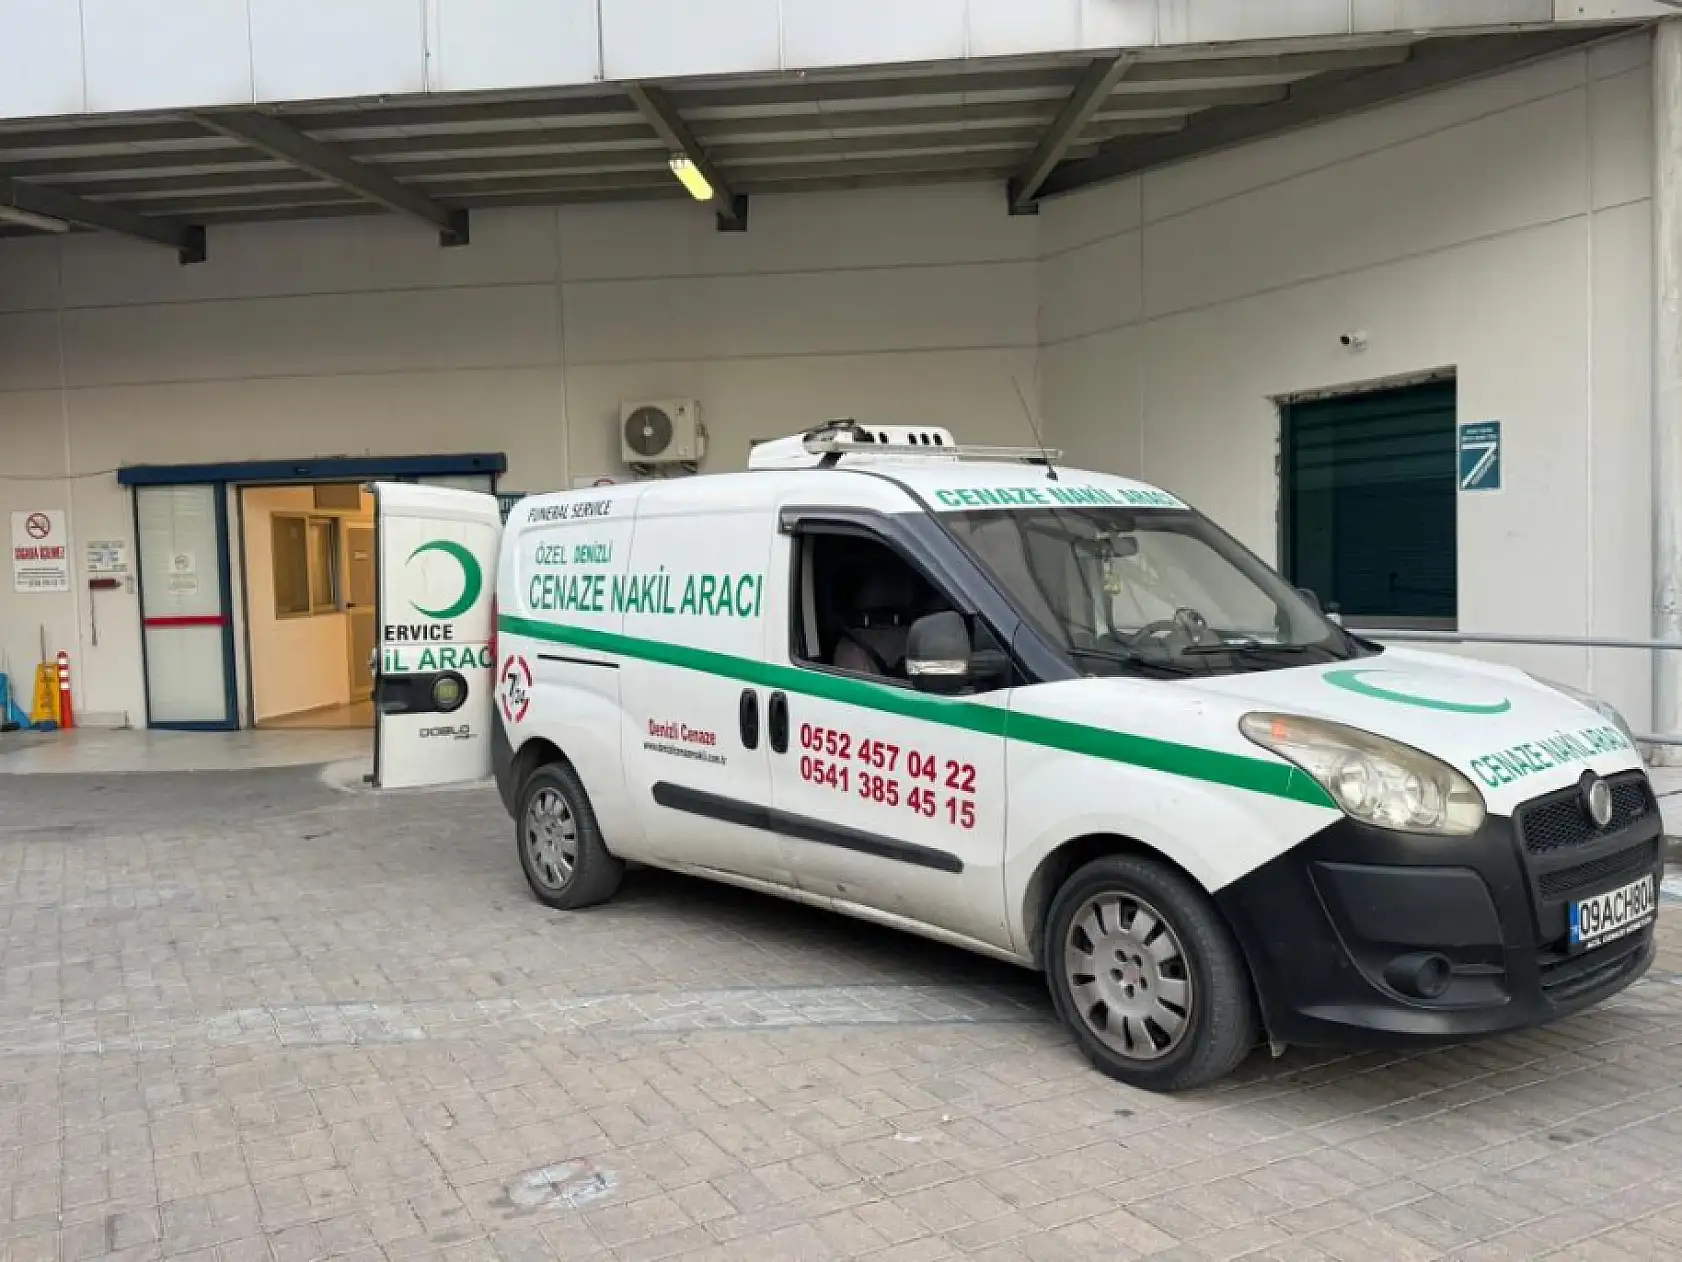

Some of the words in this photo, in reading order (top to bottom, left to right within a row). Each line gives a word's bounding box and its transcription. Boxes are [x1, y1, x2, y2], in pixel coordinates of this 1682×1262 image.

[528, 503, 569, 522] FUNERAL
[570, 500, 613, 518] SERVICE
[935, 488, 1050, 506] CENAZE
[535, 540, 568, 565] ÖZEL
[530, 573, 605, 612] CENAZE
[611, 564, 676, 613] NAKİL
[678, 573, 763, 617] ARACI
[384, 624, 454, 641] ERVICE
[649, 717, 679, 740] Denizli
[680, 722, 717, 746] Cenaze
[800, 723, 851, 760] 0552
[857, 738, 900, 771] 457
[907, 751, 938, 782] 04
[945, 760, 977, 793] 22
[1470, 743, 1554, 788] CENAZE
[800, 756, 849, 793] 0541
[858, 771, 900, 807] 385
[907, 787, 936, 817] 45
[945, 797, 976, 829] 15
